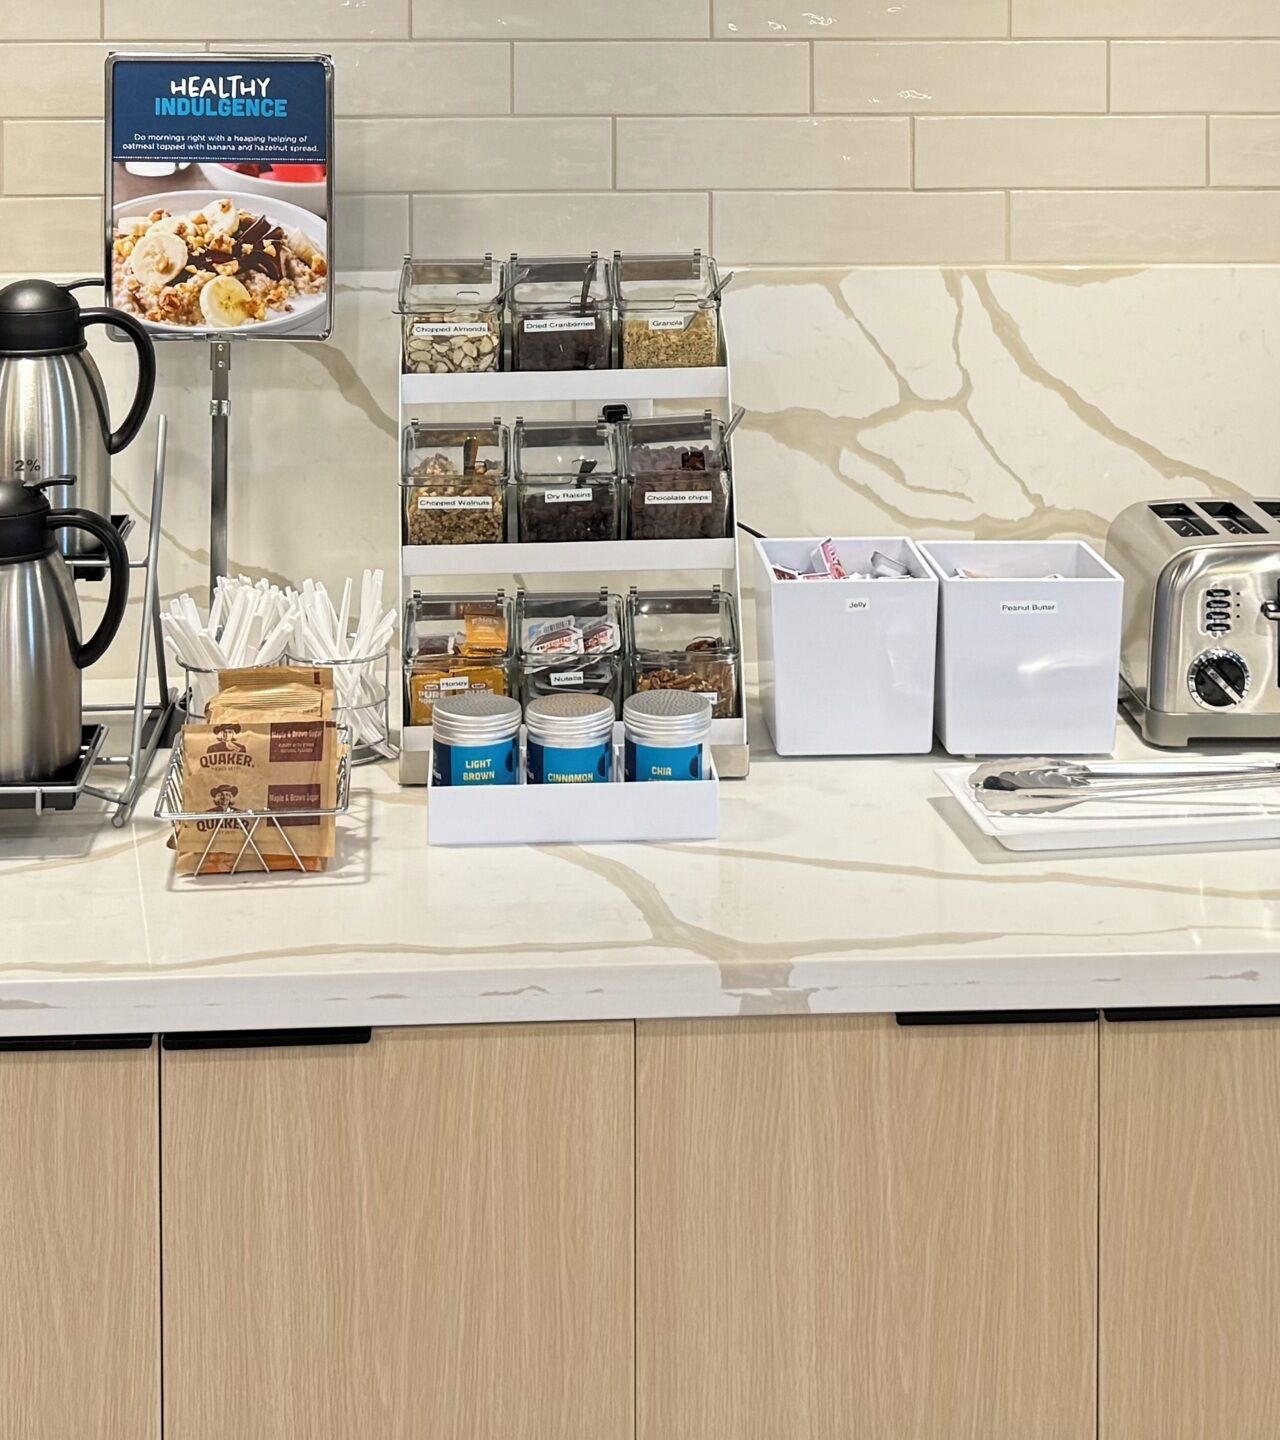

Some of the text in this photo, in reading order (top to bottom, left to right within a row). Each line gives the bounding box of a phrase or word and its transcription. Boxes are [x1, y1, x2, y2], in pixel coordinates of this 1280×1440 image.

[170, 75, 270, 98] HEALTHY
[154, 97, 287, 117] INDULGENCE
[134, 133, 146, 141] Do
[148, 134, 185, 143] mornings
[188, 134, 206, 143] right
[208, 134, 225, 142] with
[234, 135, 265, 144] heaping
[268, 135, 297, 144] helping
[299, 135, 308, 143] of
[156, 143, 186, 152] topped
[188, 143, 205, 151] with
[255, 144, 288, 152] hazelnut
[526, 320, 595, 330] Dried Cranberries
[652, 318, 683, 328] Granola
[415, 324, 488, 335] Chopped Almonds
[14, 459, 41, 473] 2%
[547, 491, 592, 502] Dry Raisins
[646, 494, 687, 503] Chocolate
[458, 499, 491, 508] Walnuts
[849, 600, 867, 610] Jelly
[1001, 603, 1055, 612] Peanut Butter
[441, 680, 468, 689] Honey
[465, 758, 492, 769] LIGHT
[463, 770, 495, 781] BROWN
[651, 766, 672, 776] CHIA
[547, 772, 594, 783] CINNAMON
